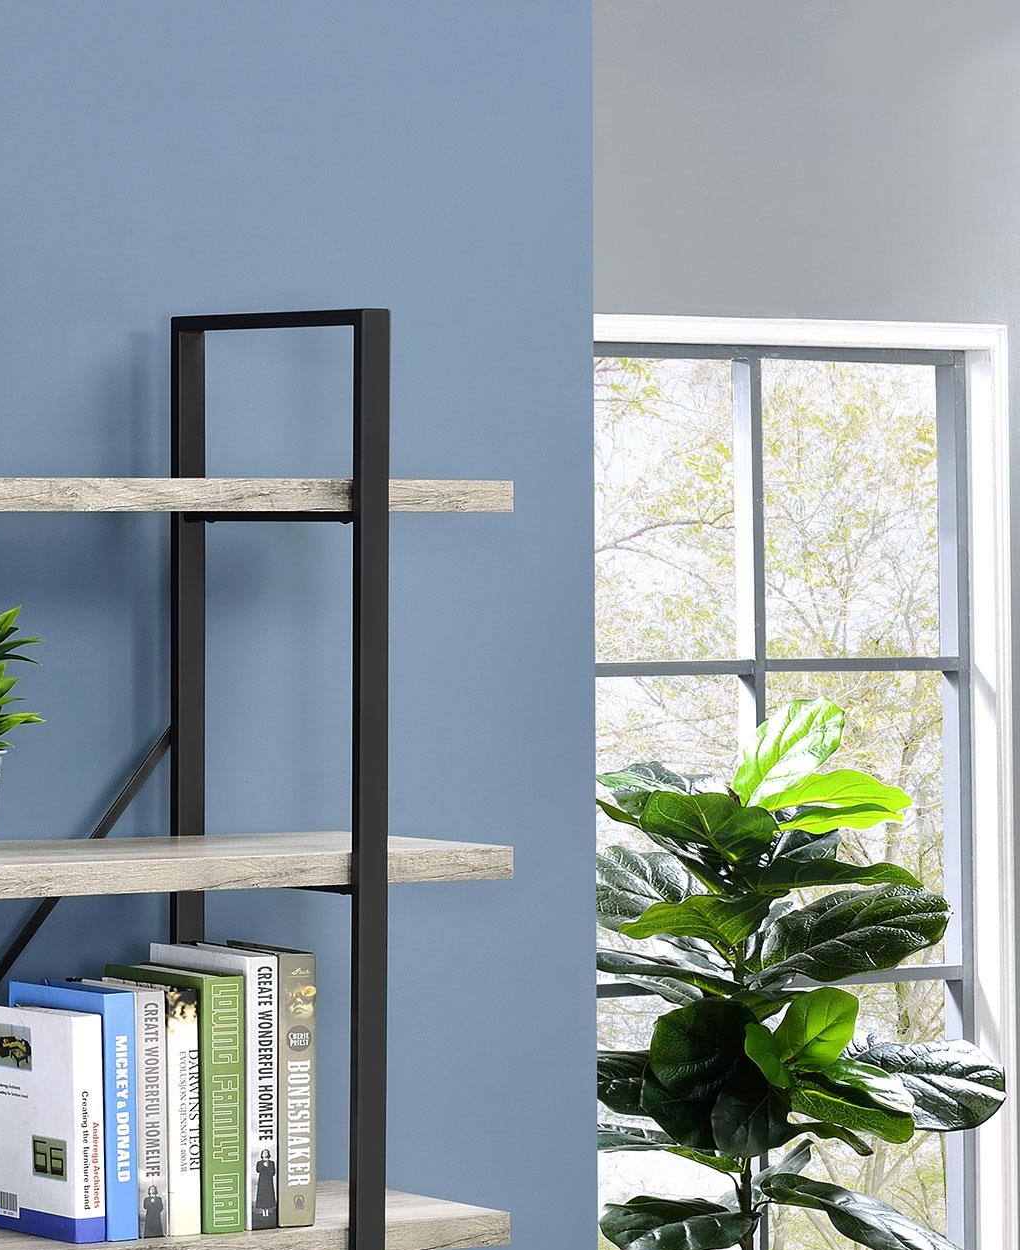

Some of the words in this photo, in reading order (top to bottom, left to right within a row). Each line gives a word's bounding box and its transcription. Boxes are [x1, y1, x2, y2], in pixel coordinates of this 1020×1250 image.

[257, 966, 272, 1006] CREATE
[144, 1002, 159, 1043] CREATE
[258, 1009, 274, 1081] WONDERFUL
[115, 1035, 129, 1100] MICKEY
[144, 1046, 160, 1118] WONDERFUL
[188, 1049, 199, 1121] DARWINS
[81, 1090, 89, 1128] Creating
[82, 1130, 90, 1144] the
[258, 1084, 274, 1141] HOMELIFE
[287, 1059, 311, 1187] BONESHAKER
[92, 1122, 100, 1164] Anderegg
[116, 1111, 131, 1183] DONALD
[145, 1121, 161, 1177] HOMELIFE
[189, 1128, 200, 1171] TEORI
[93, 1165, 101, 1209] Architects
